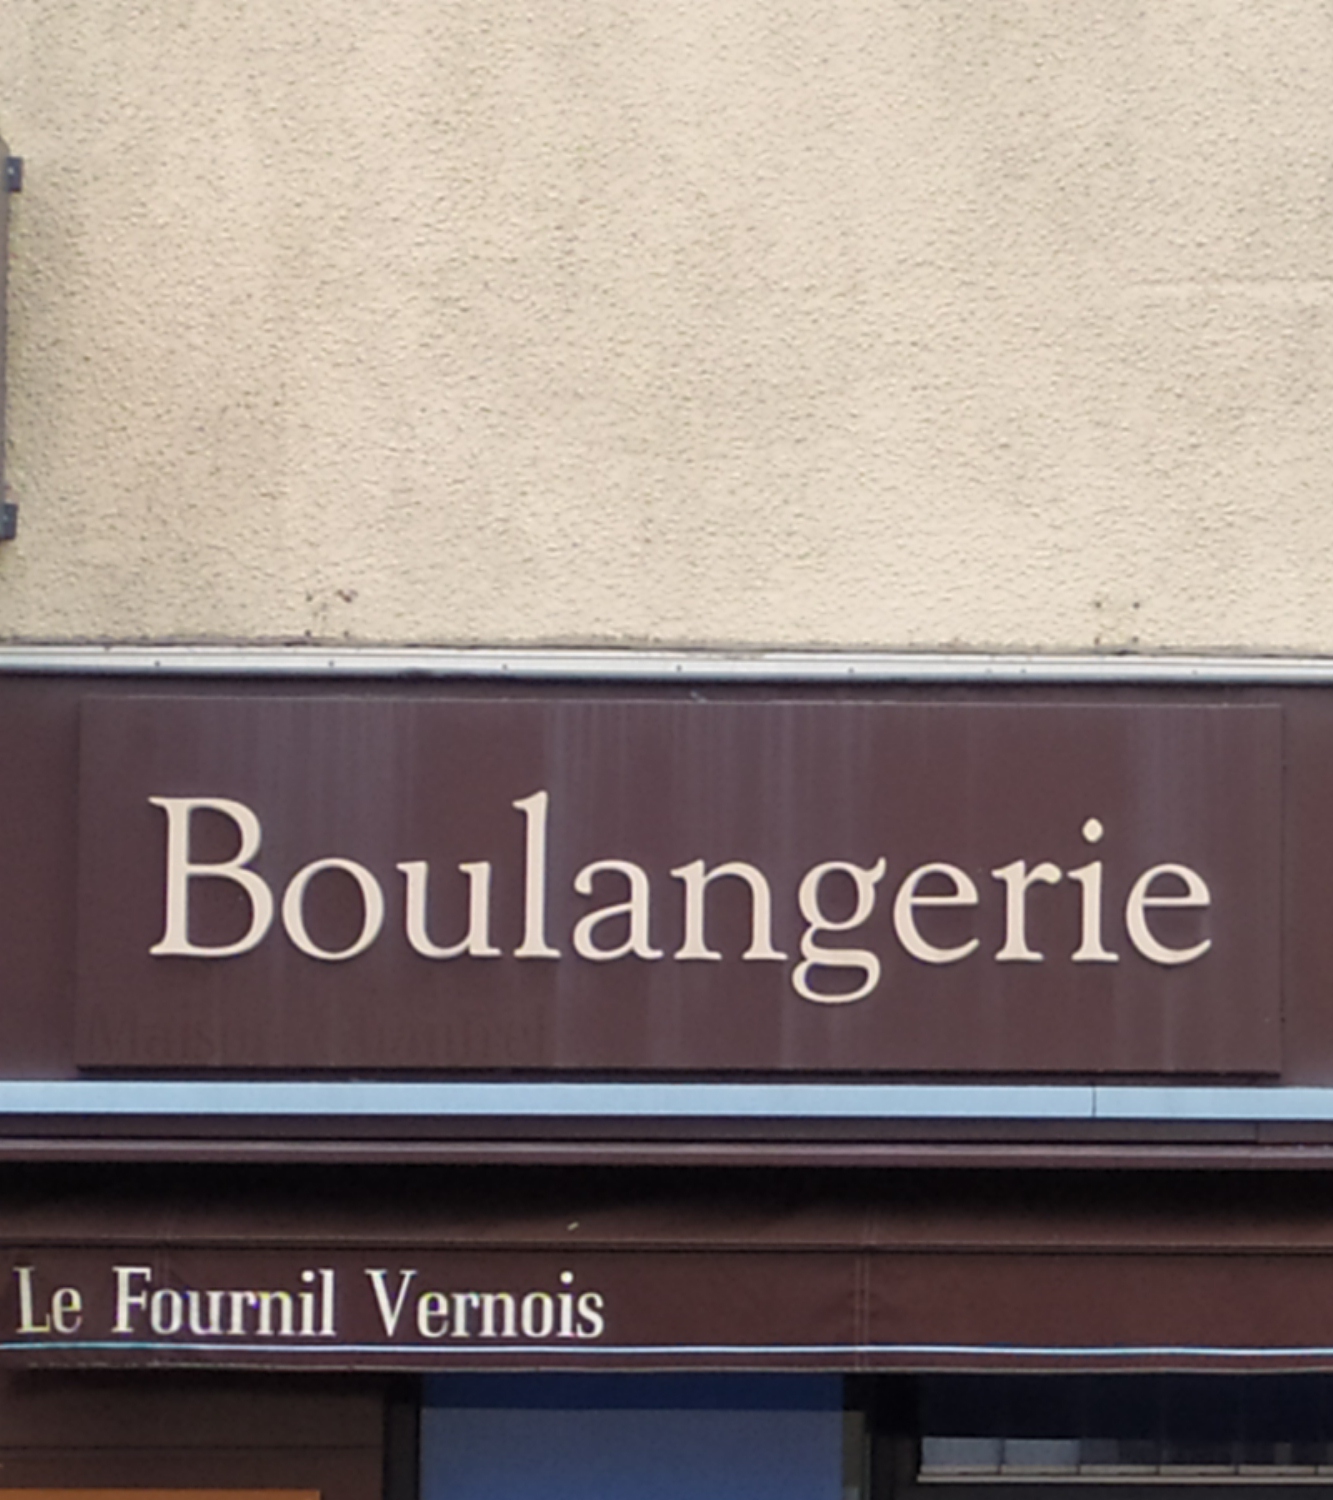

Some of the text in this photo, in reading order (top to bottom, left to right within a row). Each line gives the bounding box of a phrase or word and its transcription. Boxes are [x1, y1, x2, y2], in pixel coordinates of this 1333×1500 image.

[148, 788, 1212, 1005] Boulangerie
[15, 1267, 604, 1338] Le Fournil Vernois
